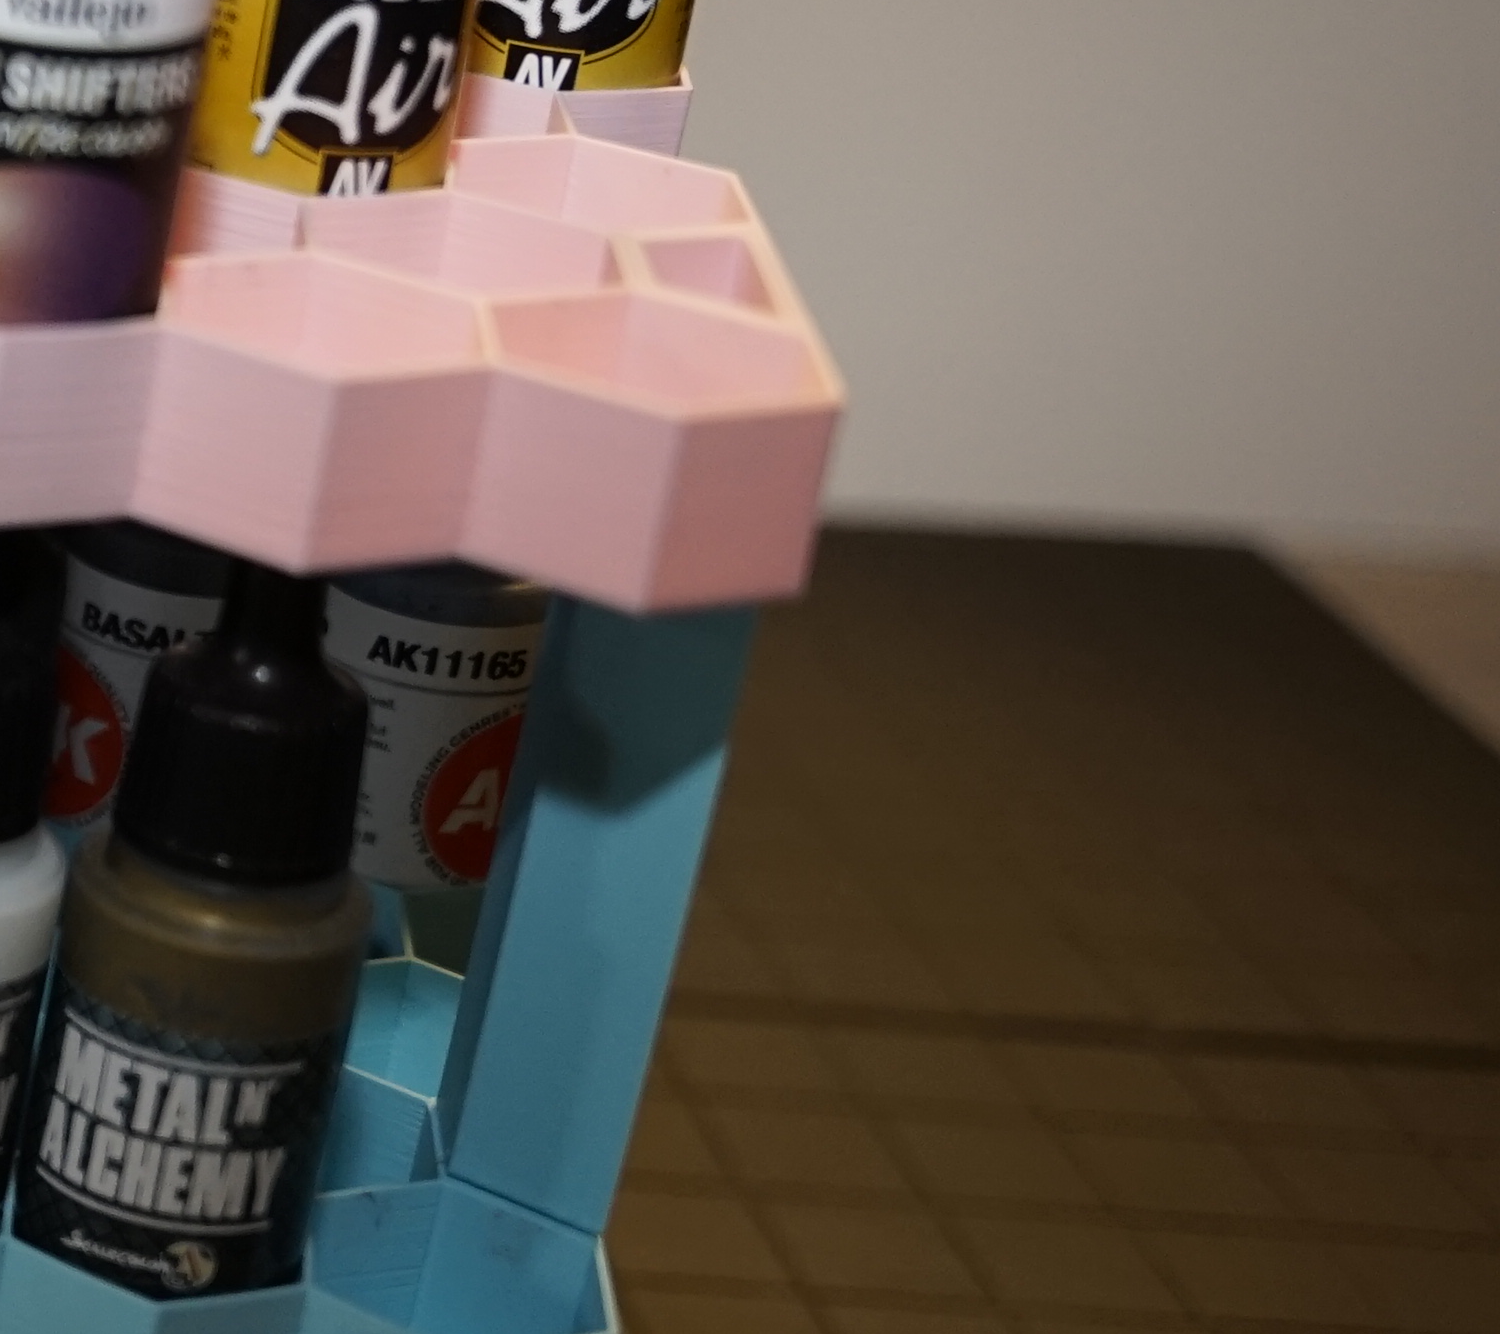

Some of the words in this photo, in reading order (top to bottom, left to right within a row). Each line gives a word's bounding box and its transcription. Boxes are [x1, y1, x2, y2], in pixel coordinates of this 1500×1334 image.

[251, 3, 456, 155] Air
[367, 634, 528, 681] AK11165
[55, 1021, 233, 1146] METAL
[39, 1094, 289, 1223] ALCHEMY
